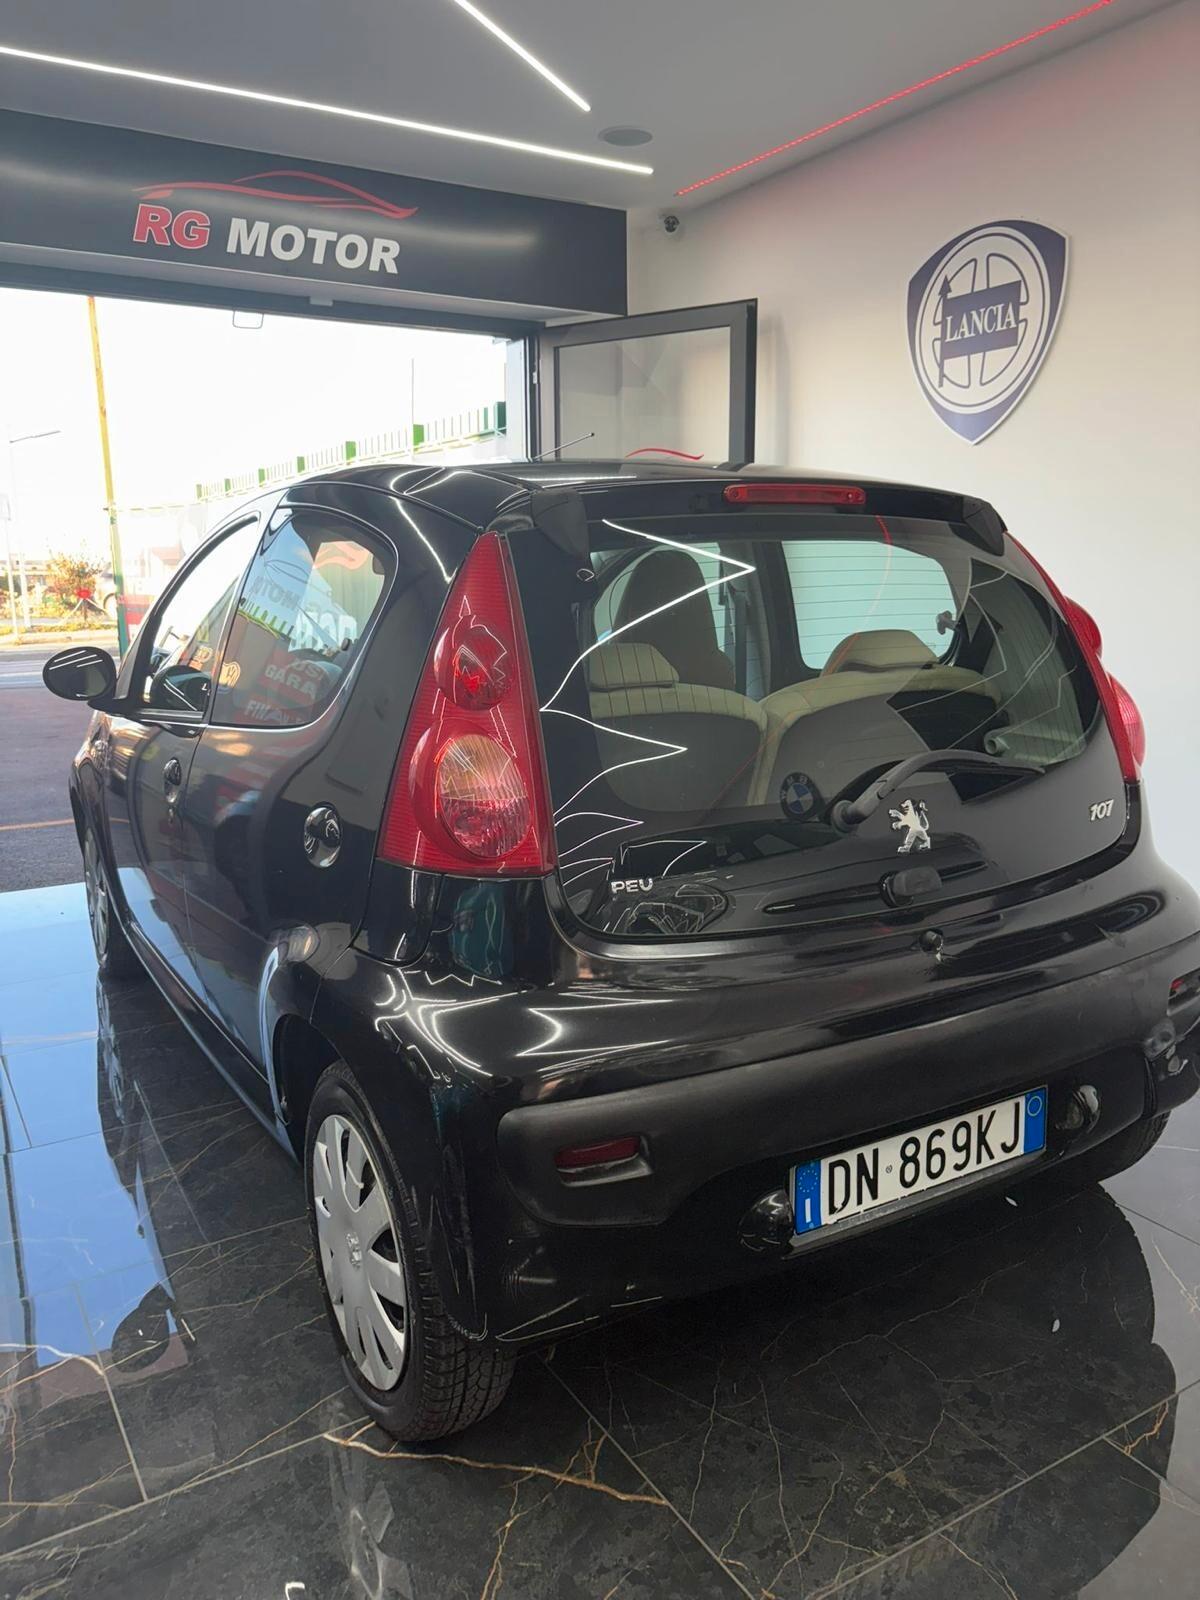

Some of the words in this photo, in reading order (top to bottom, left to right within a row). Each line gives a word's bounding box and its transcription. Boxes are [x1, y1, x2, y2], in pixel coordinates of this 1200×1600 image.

[132, 203, 211, 249] RG
[226, 218, 402, 275] MOTOR
[945, 301, 1017, 343] LANCIA
[1089, 799, 1114, 821] 107
[828, 1148, 879, 1216] DN
[899, 1101, 1020, 1189] 869KJ
